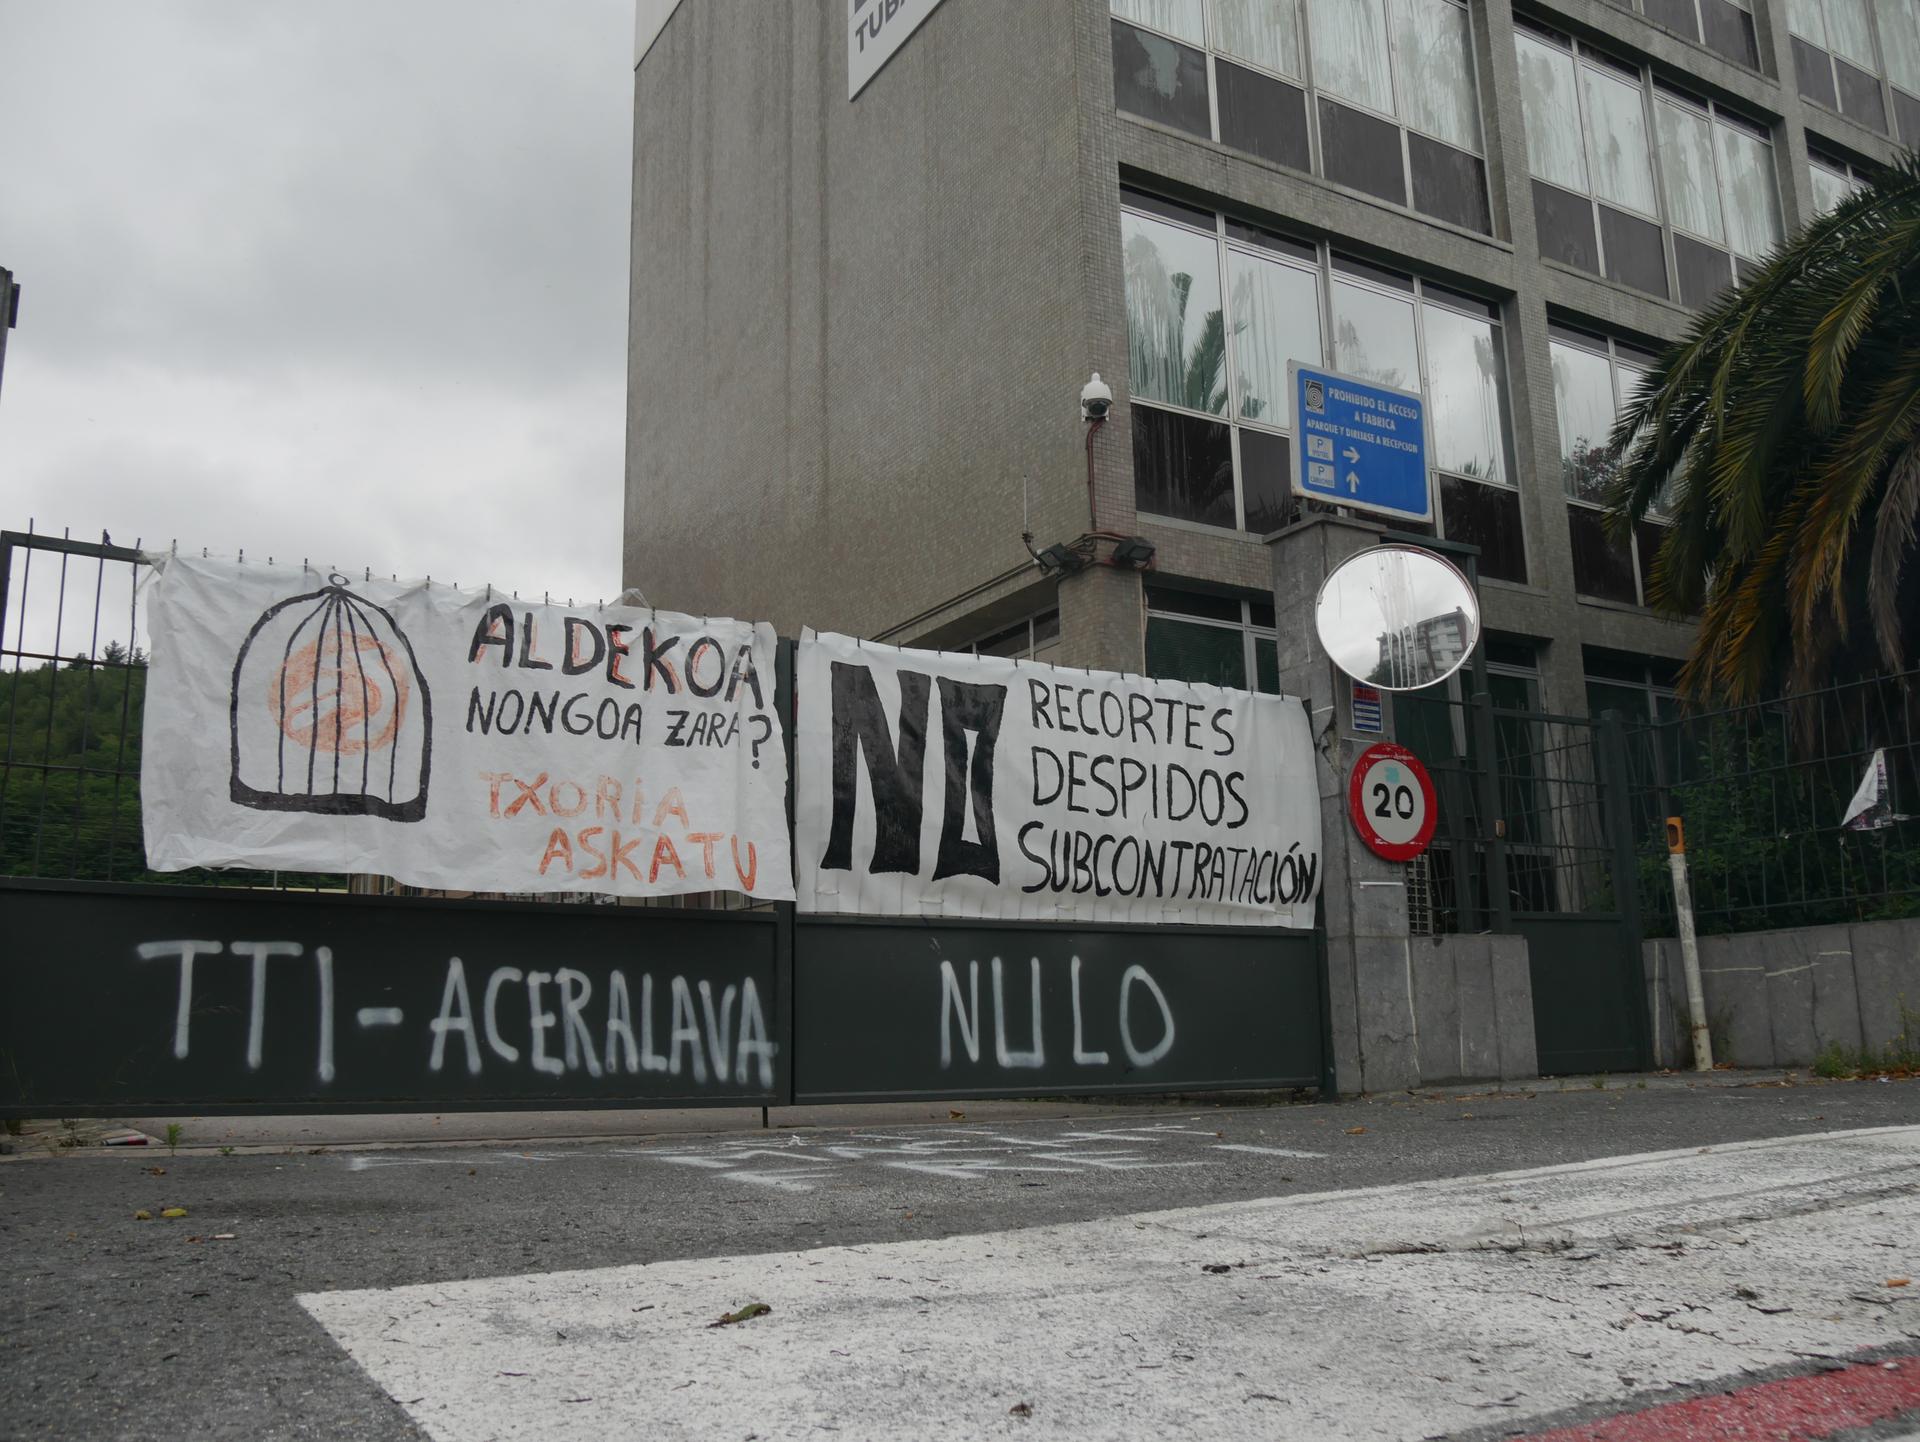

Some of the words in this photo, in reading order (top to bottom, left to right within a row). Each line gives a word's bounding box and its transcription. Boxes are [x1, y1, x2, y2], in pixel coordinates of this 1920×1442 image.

[1306, 418, 1339, 434] APARQUE
[1339, 426, 1345, 436] Y
[1375, 435, 1381, 445] A
[1382, 436, 1418, 454] RECEPCION
[1328, 387, 1375, 409] PROHIBIDO
[1378, 400, 1386, 412] EL
[1388, 403, 1417, 420] ACCESO
[1354, 411, 1360, 421] A
[1362, 412, 1396, 431] FABRICA
[468, 603, 764, 710] ALDEKOA
[466, 686, 643, 745] NONGOA
[664, 710, 772, 769] ZARA?
[1028, 679, 1235, 756] RECORTES
[820, 661, 1007, 886] NO
[1032, 746, 1249, 829] DESPIDOS
[1372, 783, 1414, 820] 20
[538, 827, 757, 892] ASKATU
[1017, 821, 1318, 905] SUBCONTRATACIÓN
[939, 956, 1176, 1069] NULO
